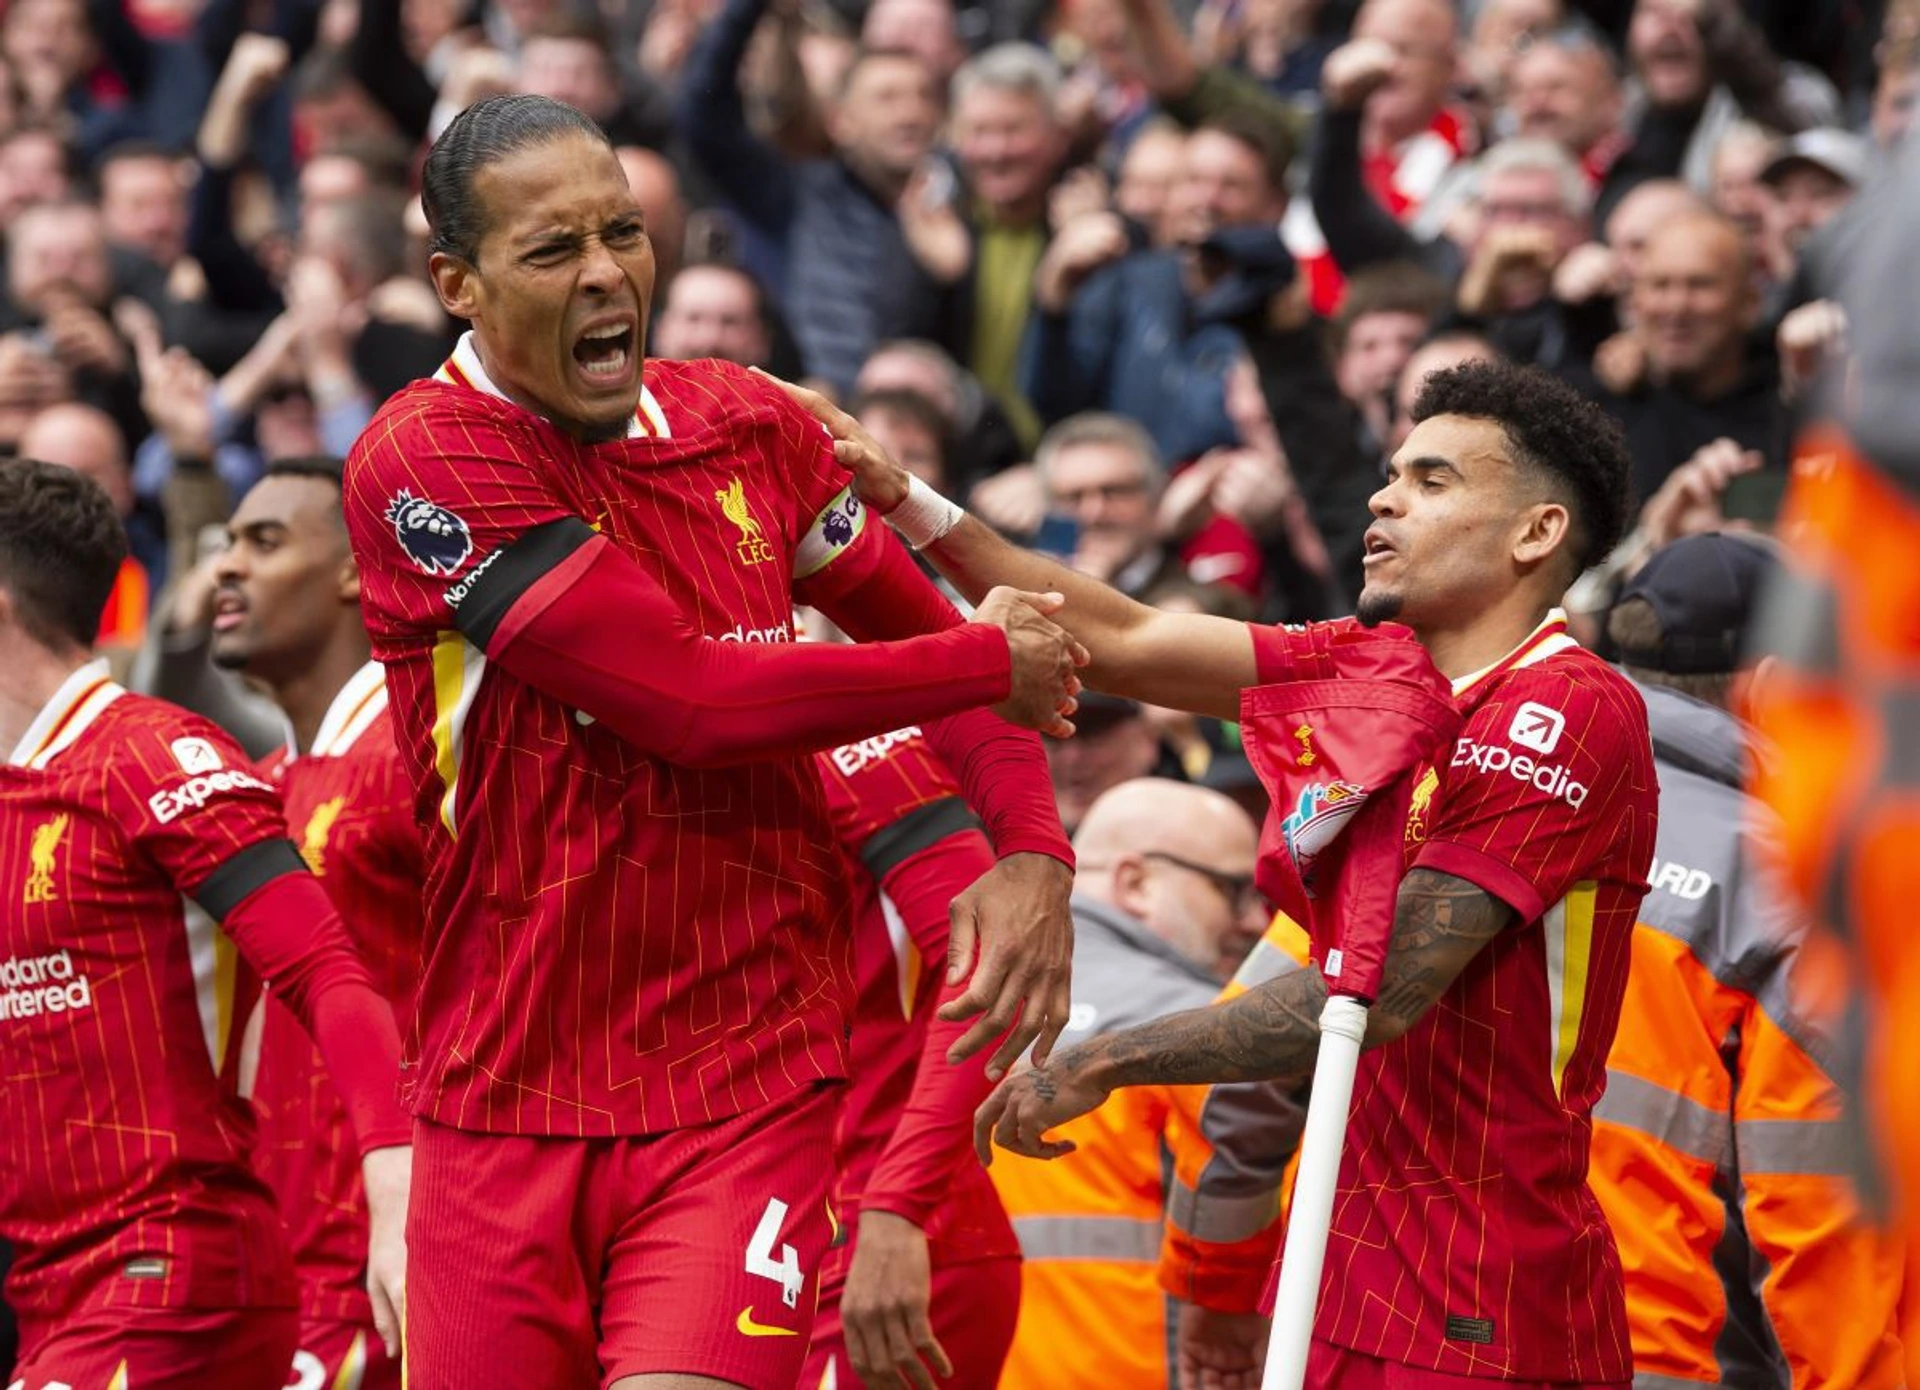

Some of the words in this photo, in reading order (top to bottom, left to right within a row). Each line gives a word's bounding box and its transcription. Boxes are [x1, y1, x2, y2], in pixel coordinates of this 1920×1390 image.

[443, 584, 468, 609] No
[704, 619, 789, 643] dard
[1450, 737, 1589, 809] Expedia
[745, 1197, 804, 1309] 4
